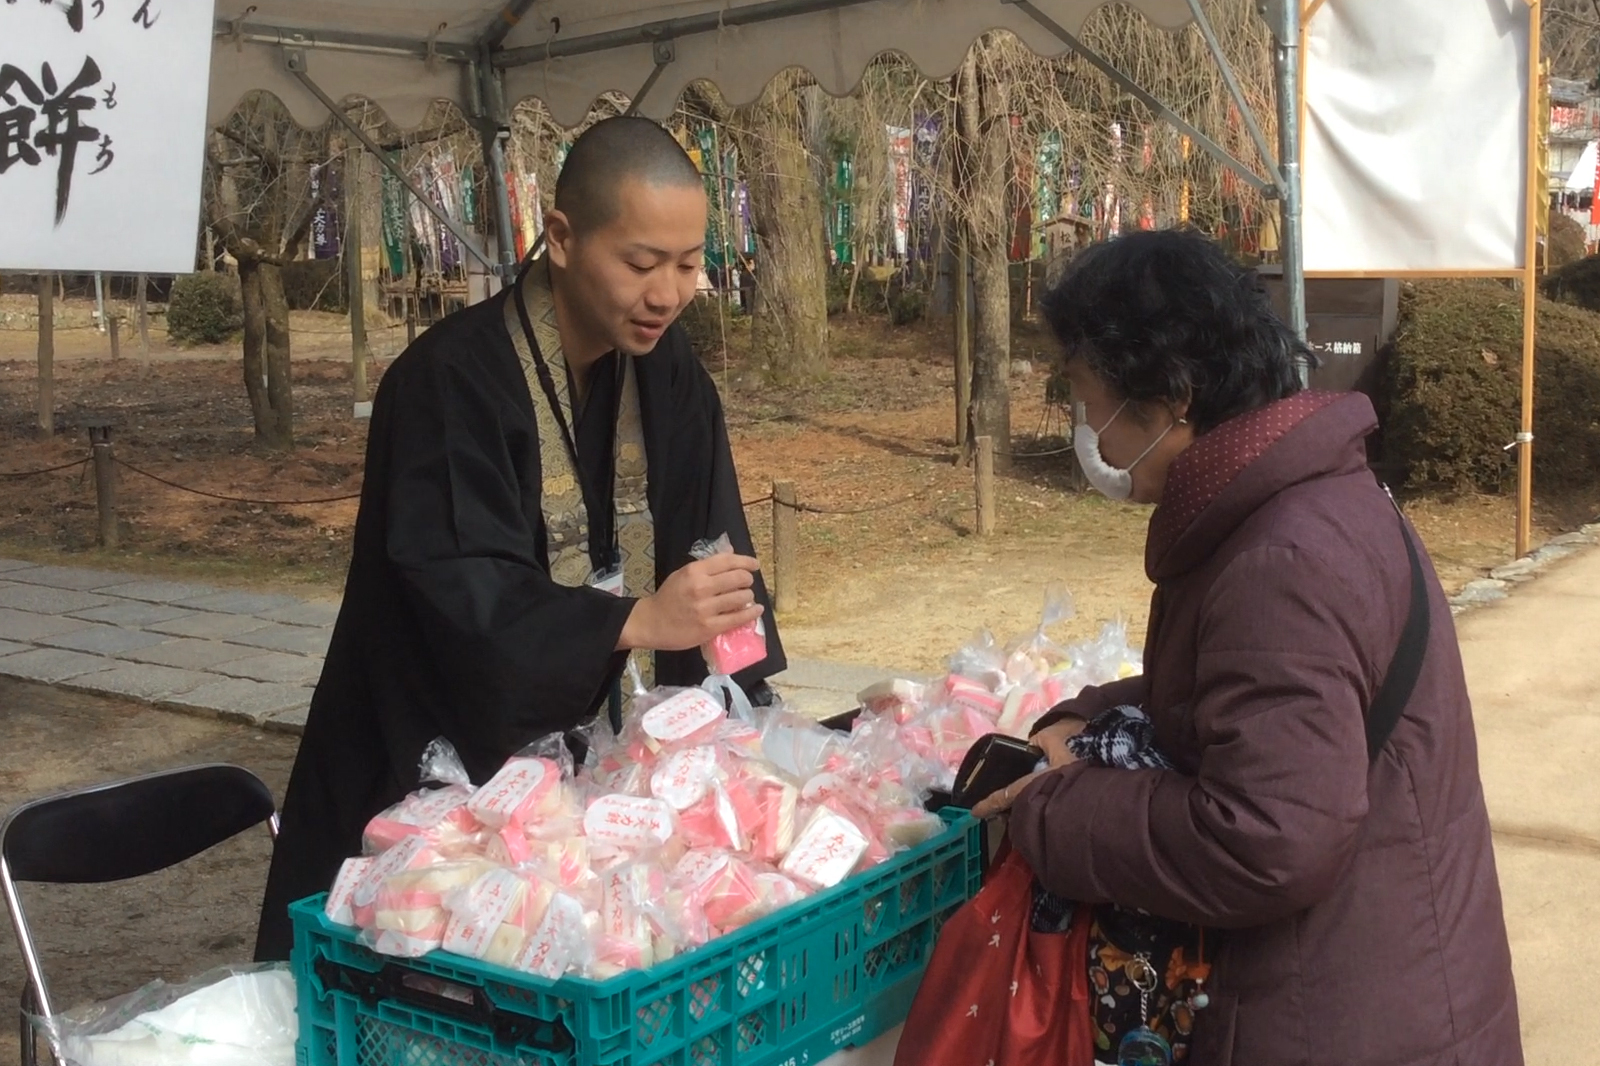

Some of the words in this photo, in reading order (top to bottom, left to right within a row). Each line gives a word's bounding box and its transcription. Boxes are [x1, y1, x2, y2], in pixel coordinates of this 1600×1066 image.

[87, 81, 118, 175] もち
[610, 873, 623, 934] 五大力餅
